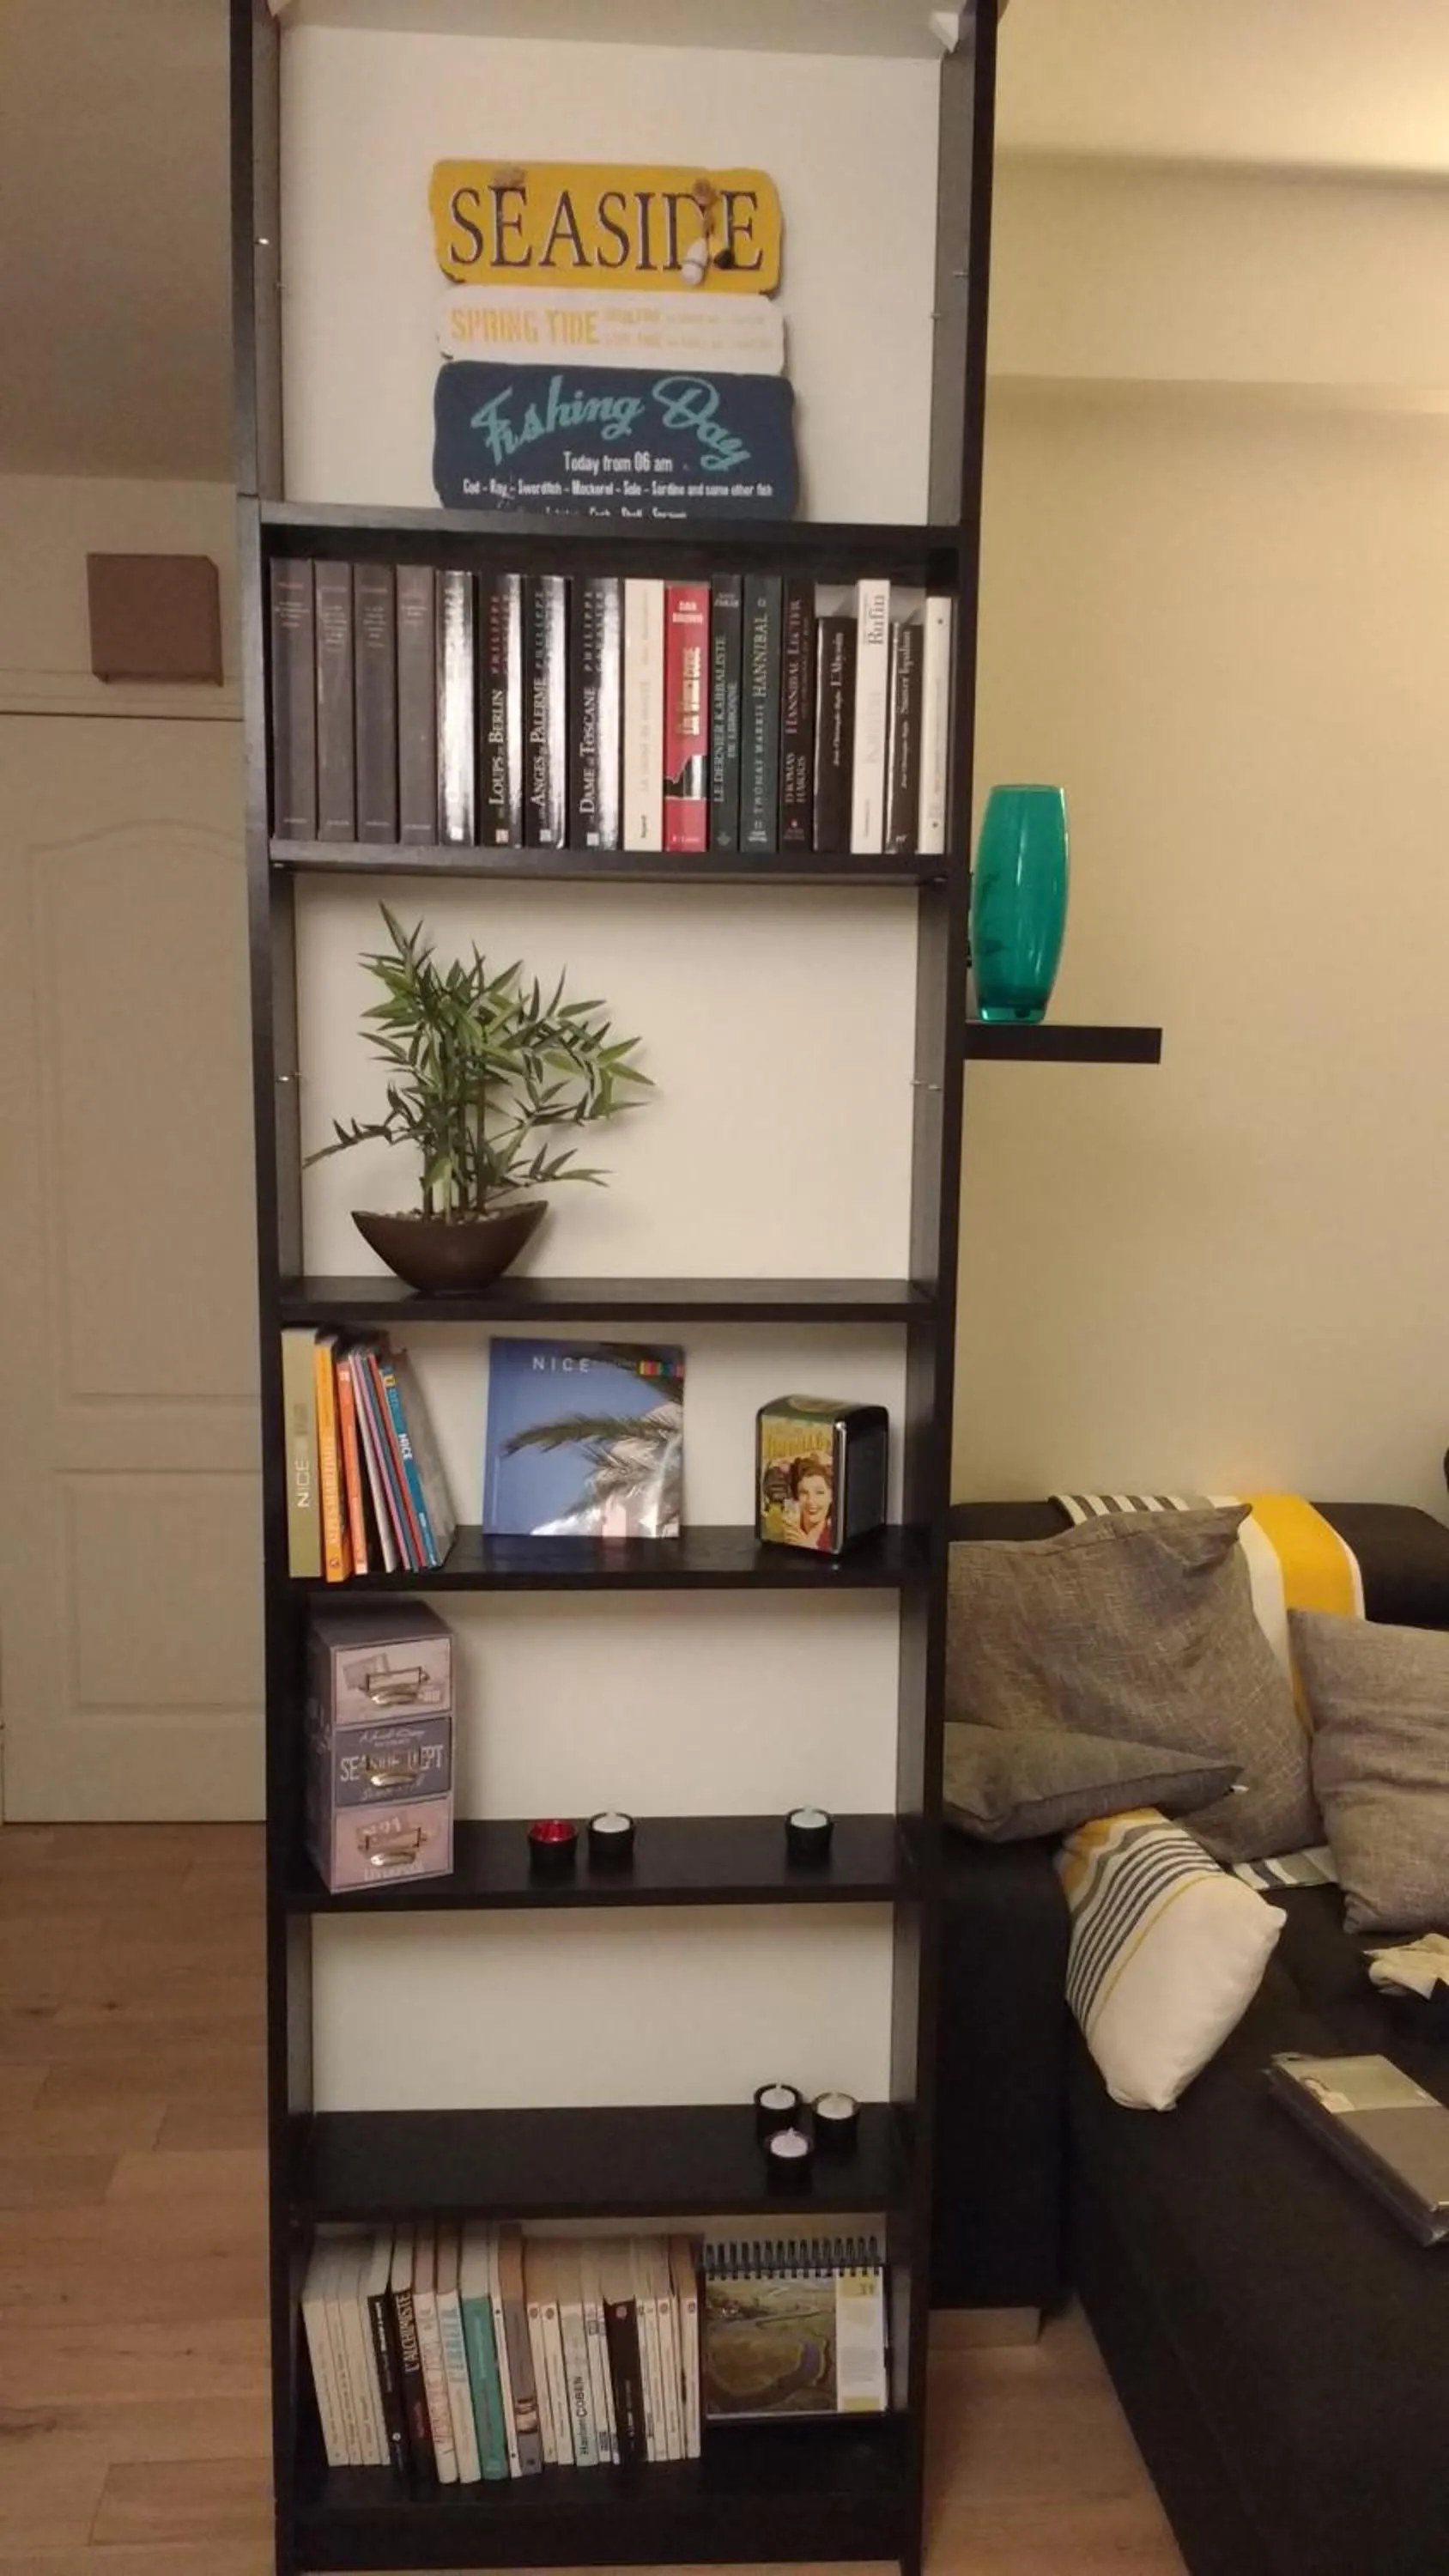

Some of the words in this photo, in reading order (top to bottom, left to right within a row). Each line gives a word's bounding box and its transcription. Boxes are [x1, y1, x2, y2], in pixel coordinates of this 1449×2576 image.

[450, 185, 764, 271] SEASIDE
[451, 308, 538, 343] SPRING
[545, 309, 599, 345] TIDE
[470, 374, 646, 466] Fishing
[652, 375, 752, 472] Day
[463, 477, 481, 495] Cod
[688, 482, 704, 496] and
[563, 450, 600, 477] Today
[603, 455, 632, 472] from
[634, 450, 651, 472] 06
[653, 458, 673, 472] am
[868, 594, 885, 645] Rufin
[752, 613, 768, 697] HANNIBAL
[532, 1356, 591, 1373] NICE
[296, 1460, 310, 1509] NICE
[396, 2288, 421, 2372] L'ALCHIMISTE
[573, 2375, 588, 2418] COBEN
